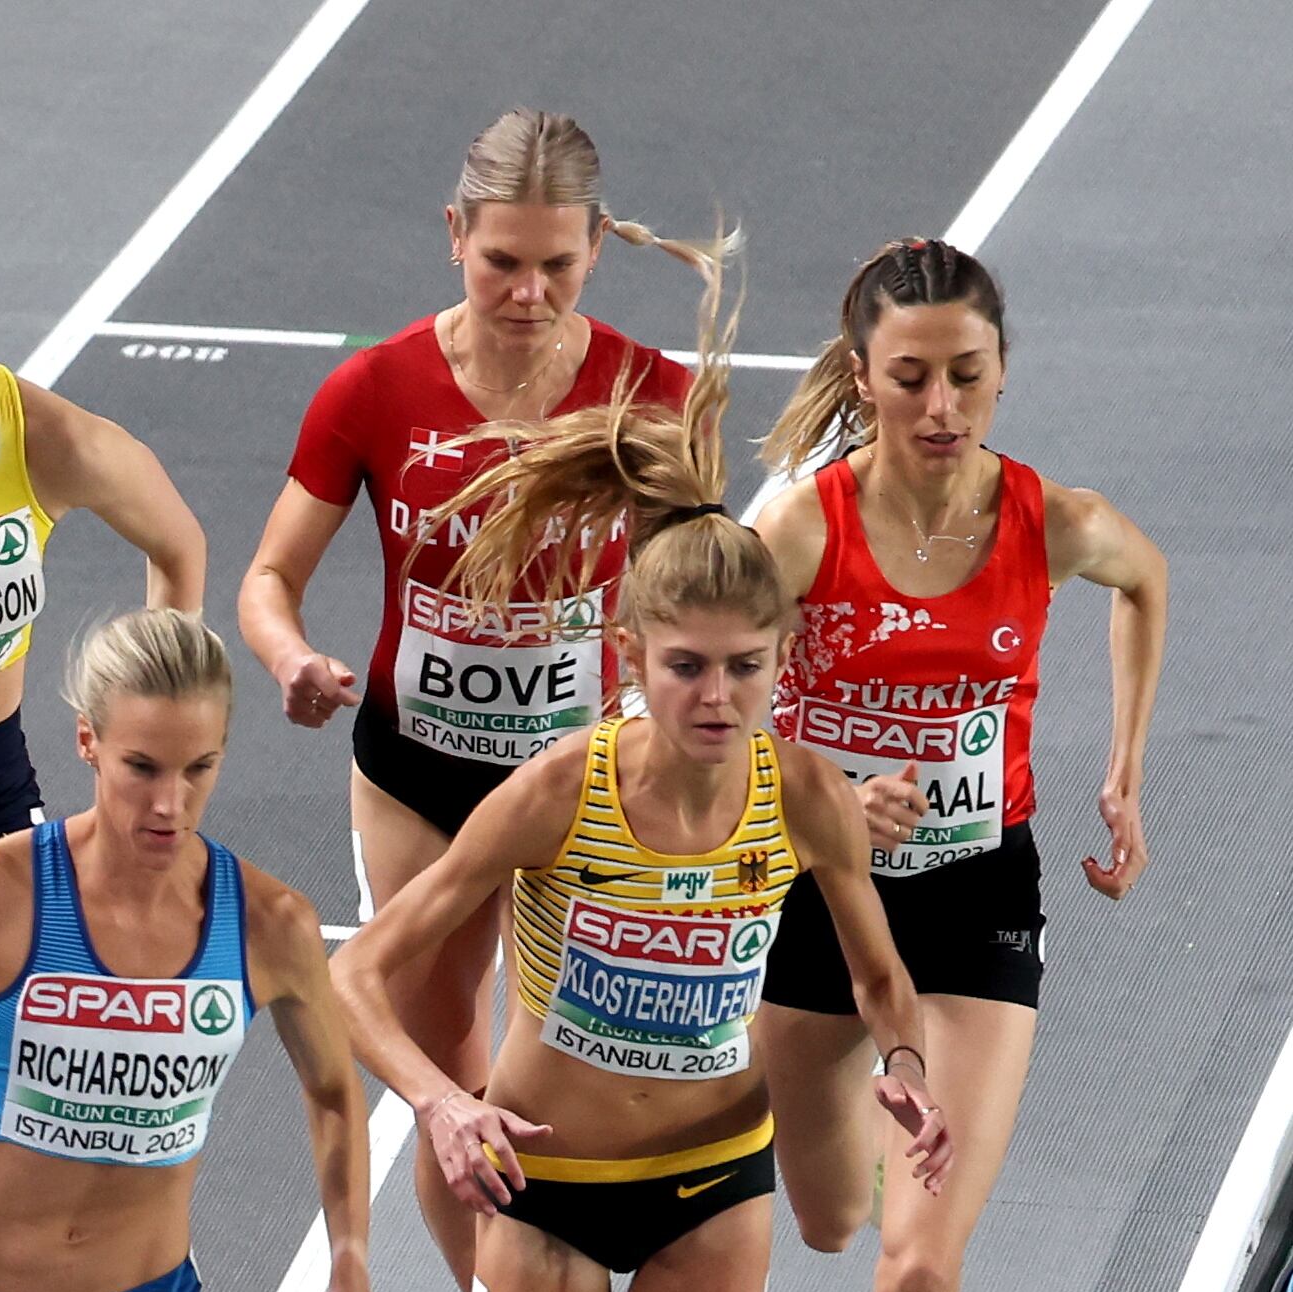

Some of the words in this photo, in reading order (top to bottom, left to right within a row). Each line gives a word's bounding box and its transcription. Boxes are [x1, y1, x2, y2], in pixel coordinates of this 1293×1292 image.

[413, 592, 549, 641] SPAR
[419, 651, 577, 706] BOVÉ
[835, 674, 1018, 711] TÜRKİYE
[413, 716, 523, 759] ISTANBUL
[435, 706, 440, 720] I
[444, 708, 489, 727] RUN
[493, 714, 552, 731] CLEAN
[806, 708, 953, 755] SPAR
[575, 910, 725, 960] SPAR
[26, 982, 181, 1026] SPAR
[563, 953, 762, 1028] KLOSTERHALFEN
[17, 1039, 228, 1100] RICHARDSSON
[556, 1024, 676, 1073] ISTANBUL
[681, 1047, 737, 1074] 2023
[15, 1113, 140, 1155] ISTANBUL
[145, 1124, 196, 1155] 2023
[50, 1101, 56, 1114] I
[61, 1103, 104, 1121] RUN
[110, 1107, 174, 1125] CLEAN
